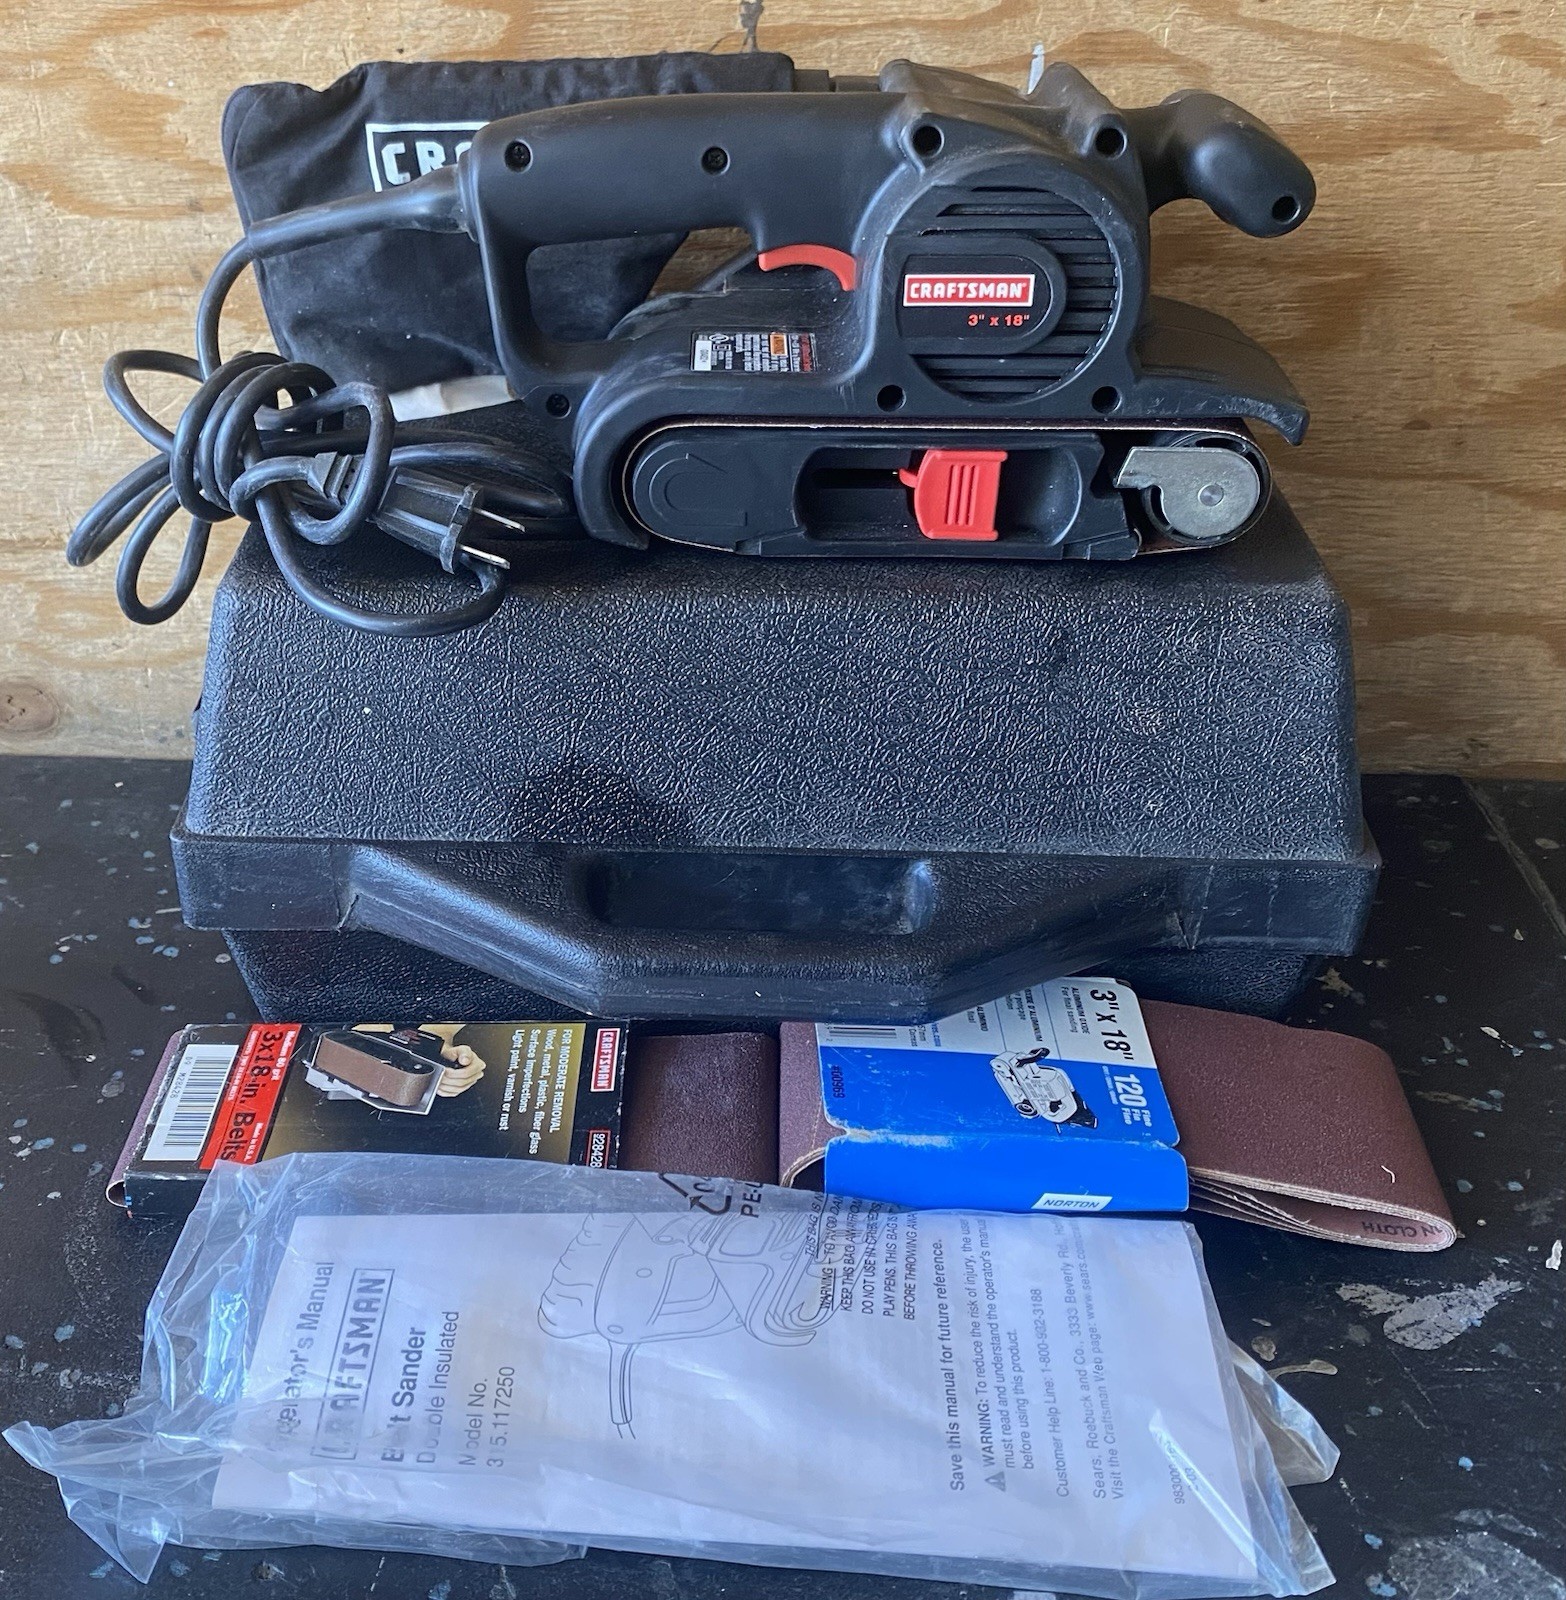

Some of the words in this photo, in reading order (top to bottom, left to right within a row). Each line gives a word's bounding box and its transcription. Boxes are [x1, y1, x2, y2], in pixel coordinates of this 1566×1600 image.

[910, 282, 1023, 298] CRAFTSMAN
[968, 314, 985, 326] 3"
[990, 317, 998, 326] x
[1005, 314, 1029, 326] 18"
[1061, 987, 1070, 997] For
[1063, 998, 1074, 1010] final
[1090, 990, 1120, 1010] 3"
[1064, 1011, 1078, 1033] sanding
[511, 1029, 524, 1048] Light
[527, 1029, 540, 1057] Surface
[543, 1029, 556, 1052] Wood,
[561, 1029, 572, 1044] FOR
[1101, 1030, 1134, 1060] 18"
[508, 1050, 520, 1071] paint,
[540, 1054, 552, 1078] metal,
[555, 1046, 570, 1089] MODERATE
[596, 1031, 614, 1087] CRAFTSMAN
[503, 1073, 516, 1101] varnish
[535, 1080, 549, 1109] plastic,
[1113, 1074, 1147, 1106] 120
[502, 1103, 511, 1112] or
[549, 1092, 562, 1132] REMOVAL
[498, 1114, 510, 1131] rust
[533, 1111, 544, 1130] fiber
[220, 1112, 256, 1160] Belts
[528, 1132, 541, 1154] glass
[590, 1133, 605, 1167] 928428
[810, 1204, 820, 1213] IS
[1043, 1200, 1100, 1208] NORTON
[807, 1215, 820, 1235] BAG
[886, 1223, 898, 1240] BAG
[1362, 1222, 1417, 1238] CLOTH
[805, 1237, 817, 1256] THIS
[843, 1245, 856, 1265] BAG
[865, 1247, 877, 1257] IN
[885, 1243, 897, 1263] THIS
[905, 1232, 917, 1280] THROWING
[960, 1237, 972, 1252] the
[842, 1267, 854, 1285] THIS
[864, 1260, 876, 1277] USE
[884, 1267, 896, 1292] PENS.
[931, 1239, 947, 1299] reference.
[962, 1256, 979, 1285] injury,
[980, 1251, 998, 1300] operator's
[819, 1268, 833, 1309] WARNING
[862, 1280, 876, 1298] NOT
[965, 1287, 978, 1297] of
[1060, 1262, 1078, 1304] Beverly
[296, 1262, 334, 1330] Manual
[840, 1287, 853, 1311] KEEP
[861, 1300, 874, 1314] DO
[883, 1294, 895, 1316] PLAY
[904, 1284, 916, 1320] BEFORE
[966, 1301, 980, 1318] risk
[984, 1303, 997, 1320] the
[1066, 1308, 1082, 1336] 3333
[935, 1303, 952, 1342] future
[969, 1322, 981, 1337] the
[428, 1311, 459, 1389] Insulated
[1088, 1322, 1104, 1353] page:
[940, 1346, 953, 1363] for
[970, 1341, 986, 1378] reduce
[986, 1323, 1005, 1383] understand
[1007, 1329, 1025, 1373] product.
[391, 1327, 426, 1407] Sander
[975, 1381, 987, 1395] To
[1011, 1375, 1024, 1395] this
[1042, 1377, 1057, 1403] Line:
[1074, 1369, 1089, 1391] and
[467, 1379, 488, 1407] No.
[941, 1368, 959, 1418] manual
[995, 1386, 1008, 1407] and
[998, 1409, 1012, 1436] read
[1015, 1398, 1029, 1428] using
[1047, 1407, 1062, 1433] Help
[1081, 1396, 1099, 1449] Roebuck
[1097, 1386, 1116, 1444] Craftsman
[945, 1423, 961, 1449] this
[978, 1399, 996, 1467] WARNING:
[1002, 1438, 1016, 1468] must
[1018, 1432, 1035, 1469] before
[1107, 1449, 1120, 1467] the
[949, 1454, 965, 1490] Save
[1050, 1438, 1070, 1497] Customer
[1091, 1454, 1108, 1499] Sears,
[1110, 1471, 1124, 1499] Visit
